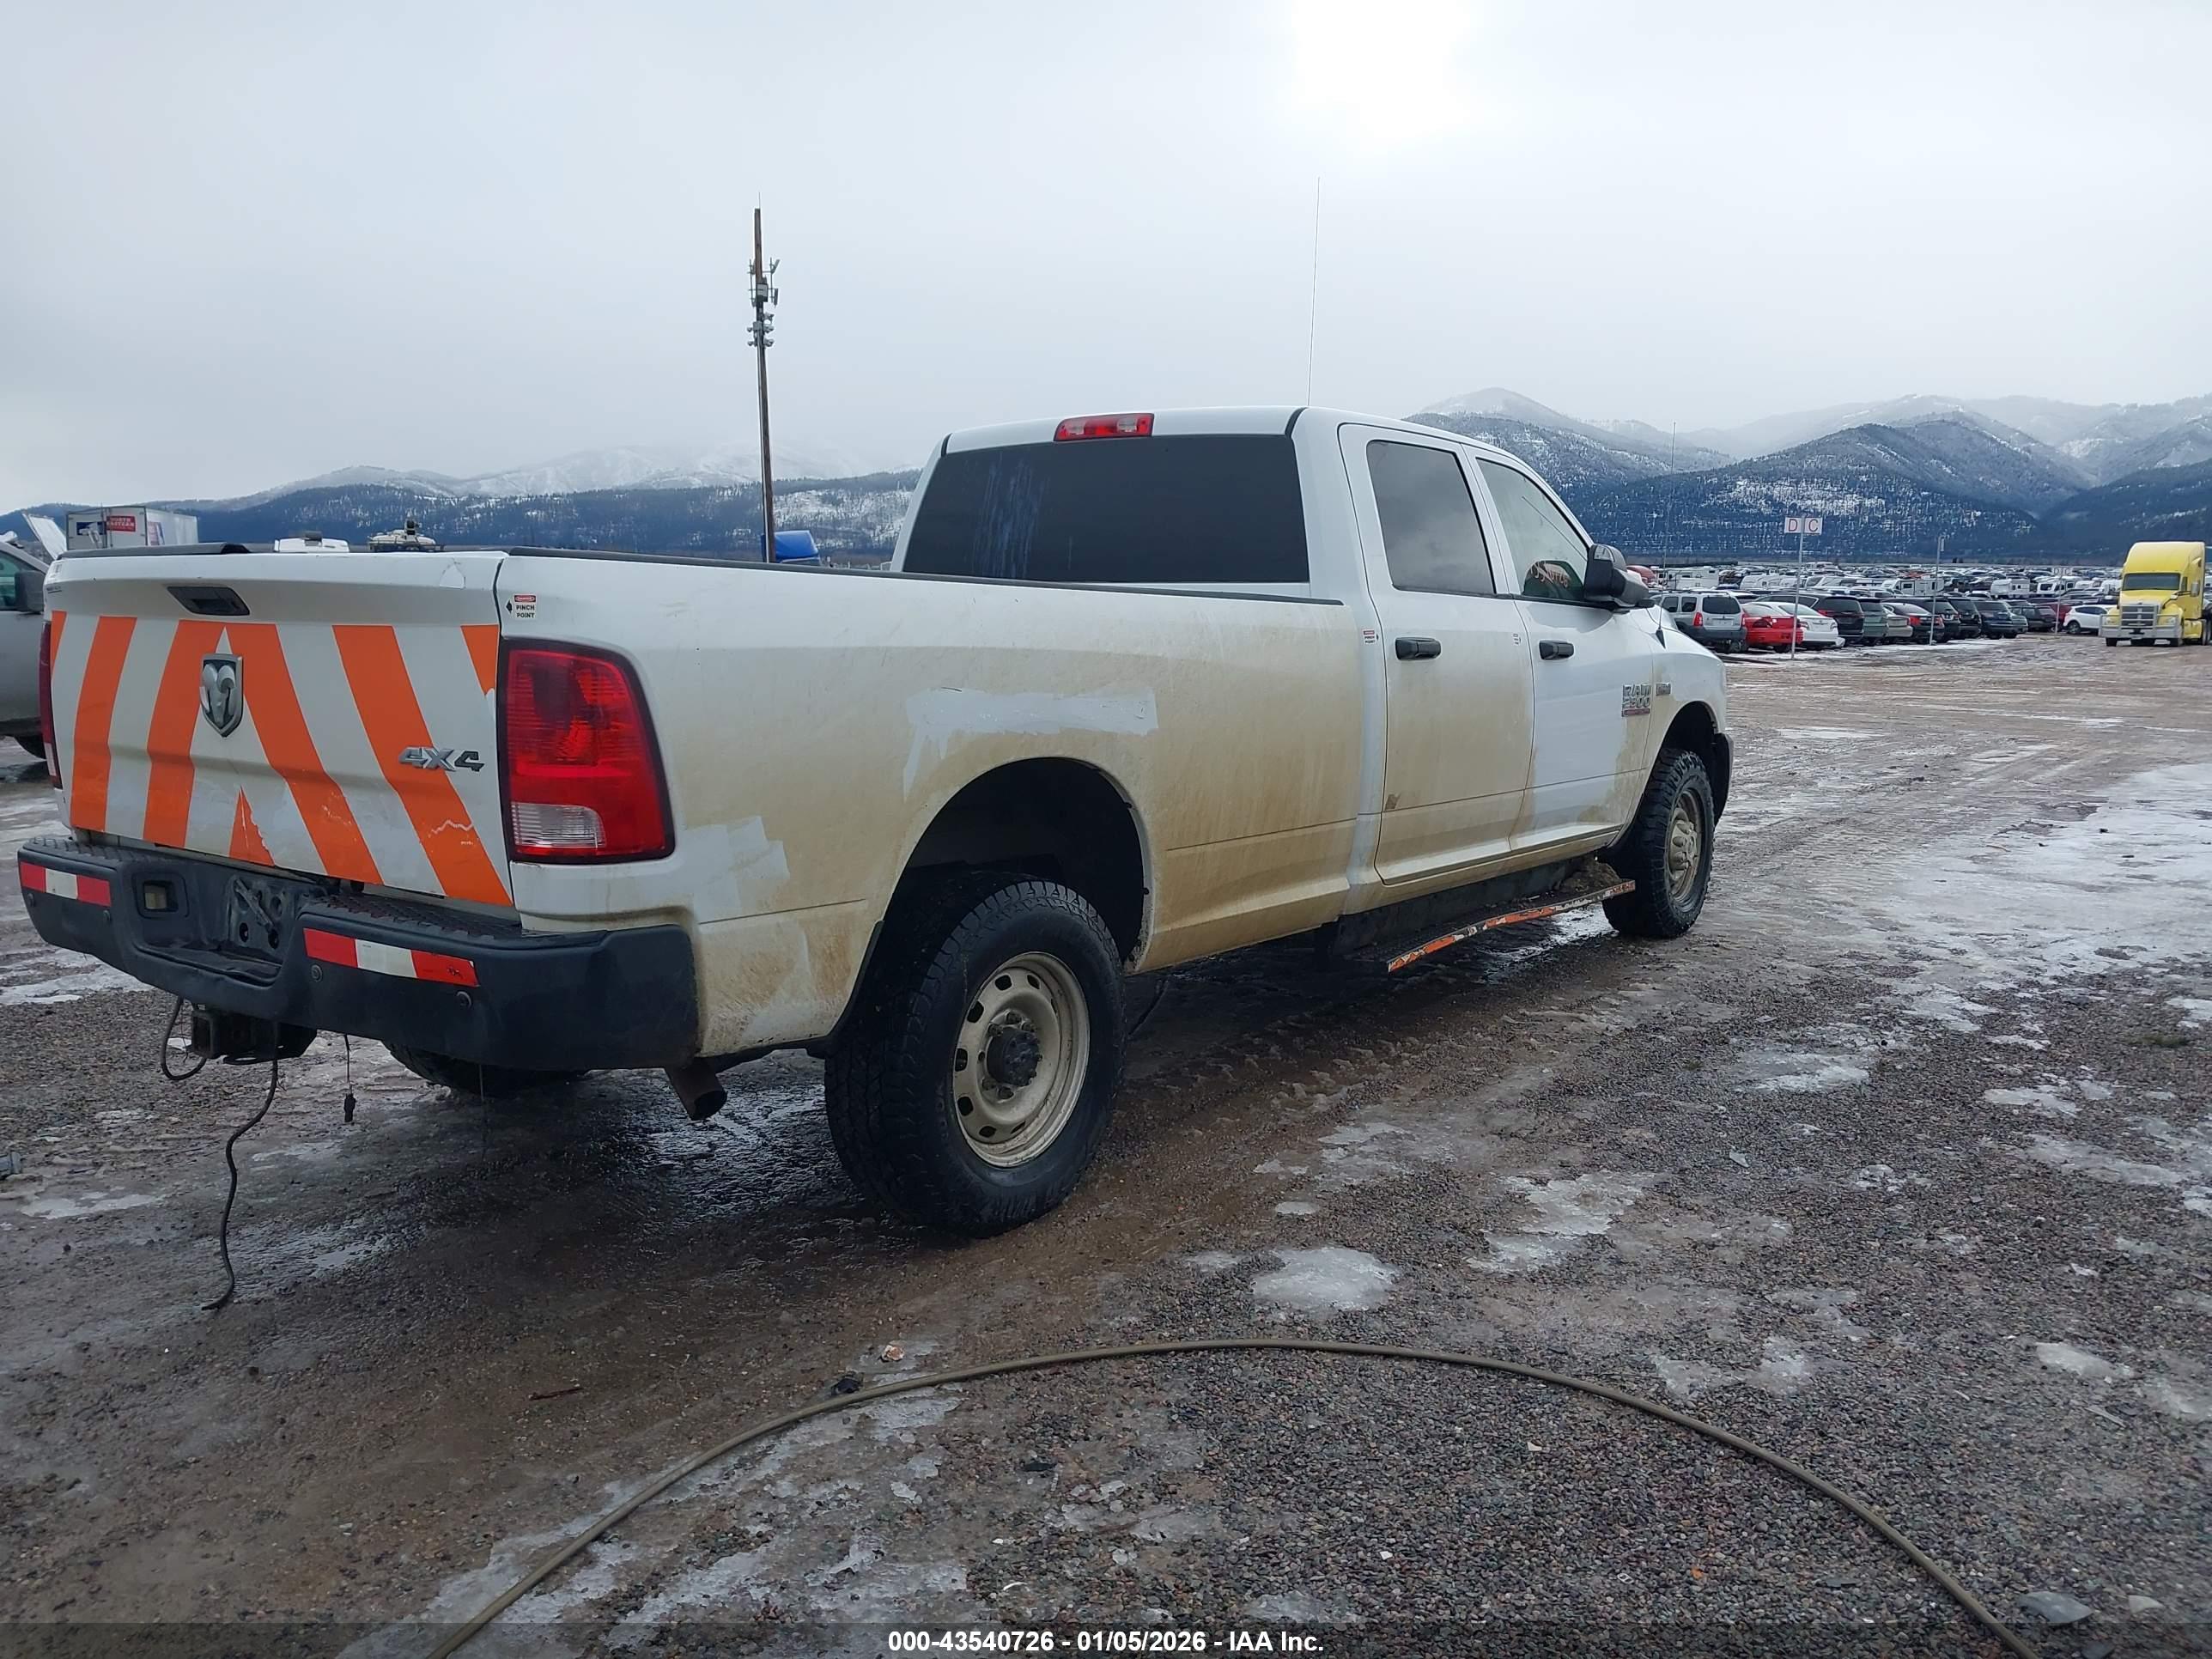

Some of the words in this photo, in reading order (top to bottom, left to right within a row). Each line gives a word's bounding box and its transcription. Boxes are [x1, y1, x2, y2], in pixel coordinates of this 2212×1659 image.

[1788, 519, 1798, 532] D
[1808, 519, 1819, 532] C
[1622, 684, 1651, 696] RAM
